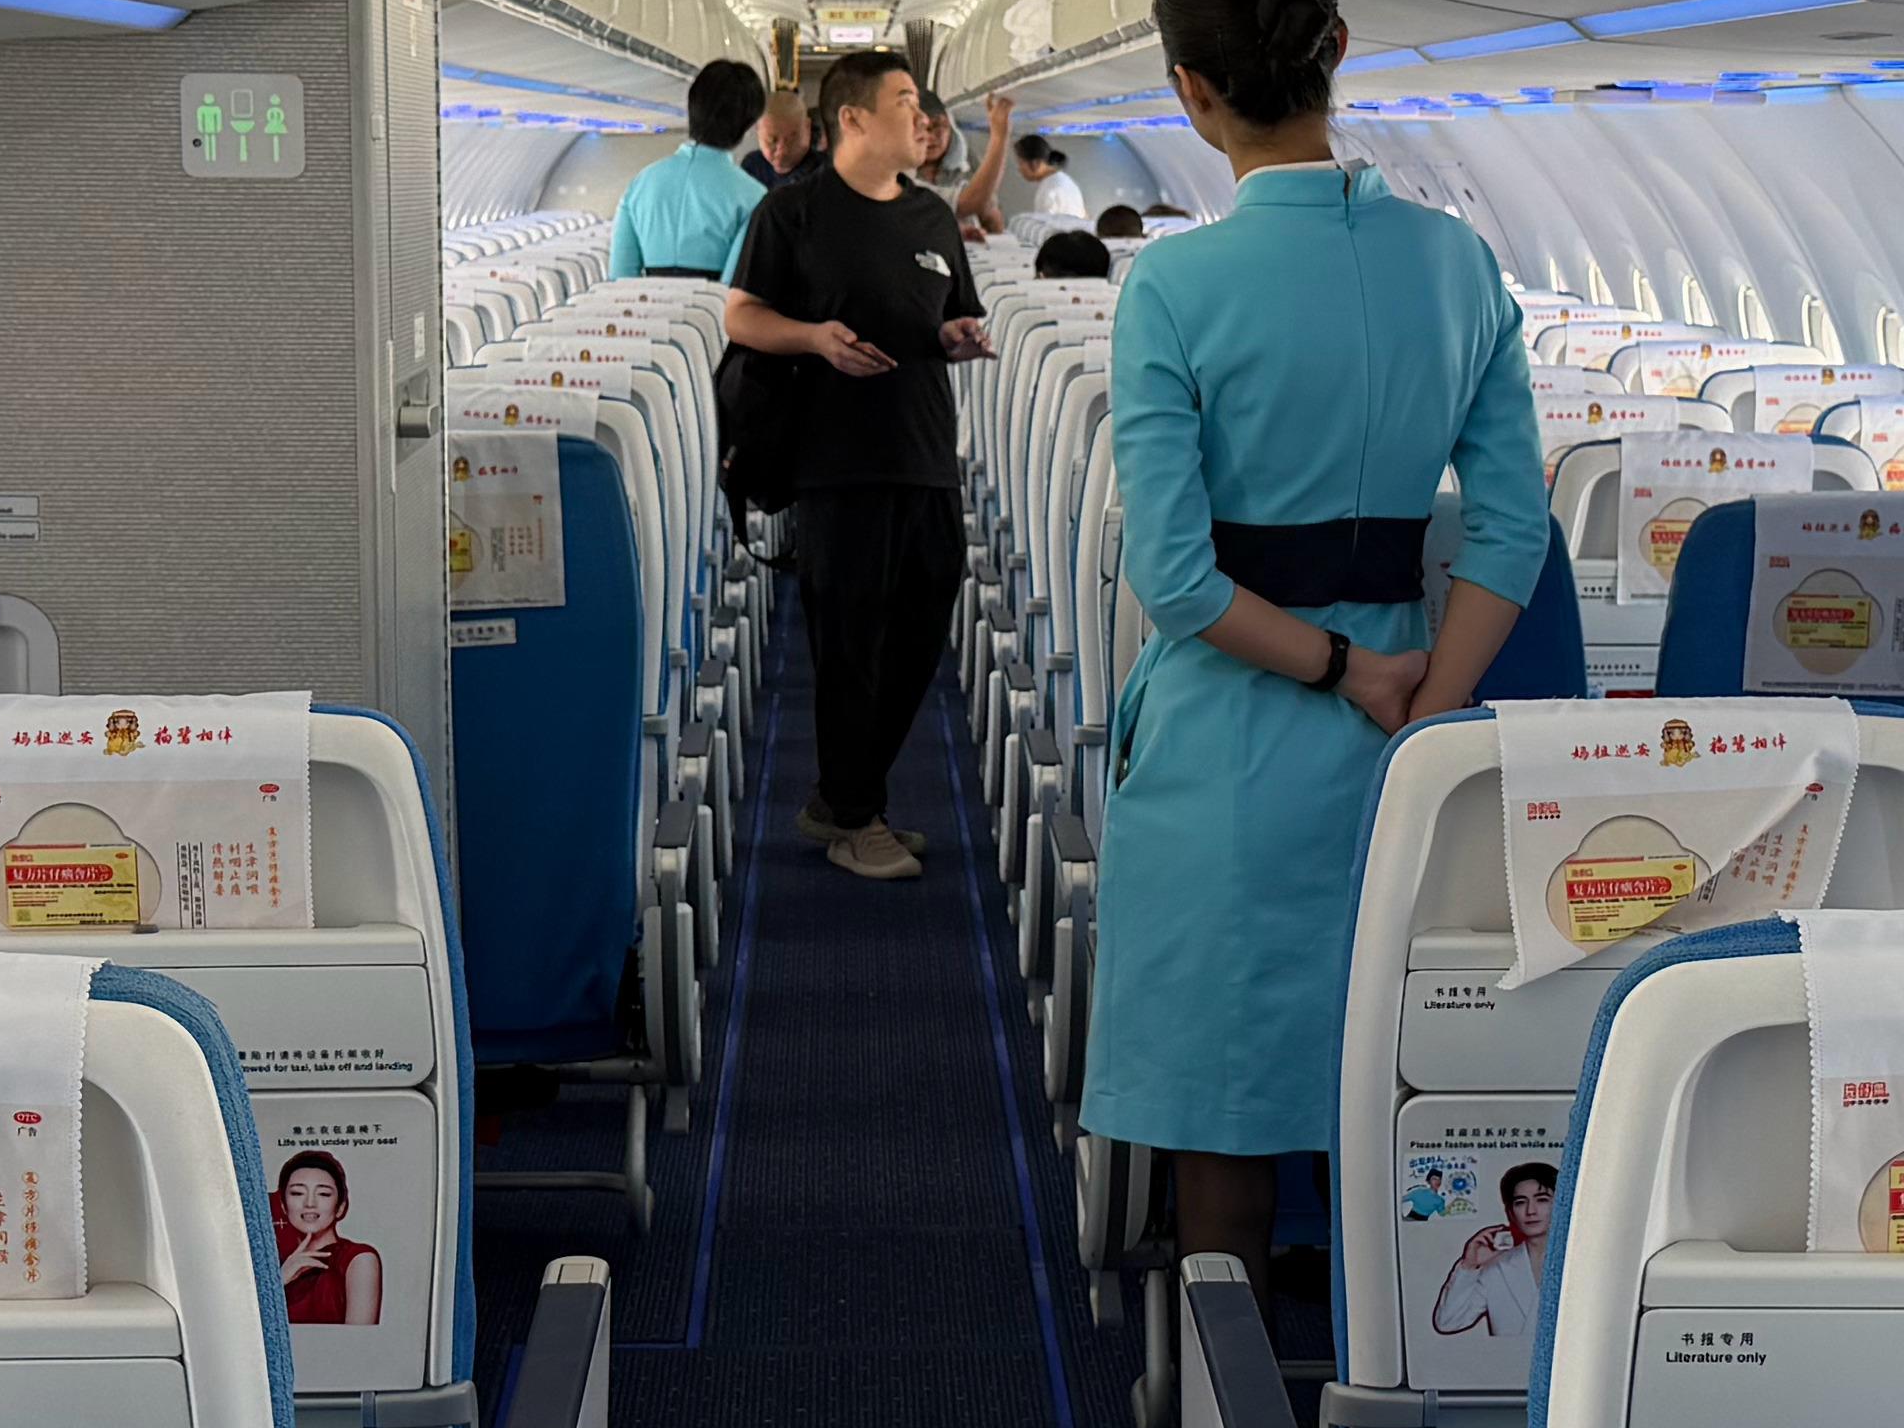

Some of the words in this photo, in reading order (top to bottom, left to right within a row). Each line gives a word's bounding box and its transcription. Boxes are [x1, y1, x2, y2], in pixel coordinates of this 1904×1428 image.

[1681, 1331, 1756, 1347] 书报专用
[1666, 1350, 1732, 1364] Literature
[1735, 1351, 1768, 1367] only
